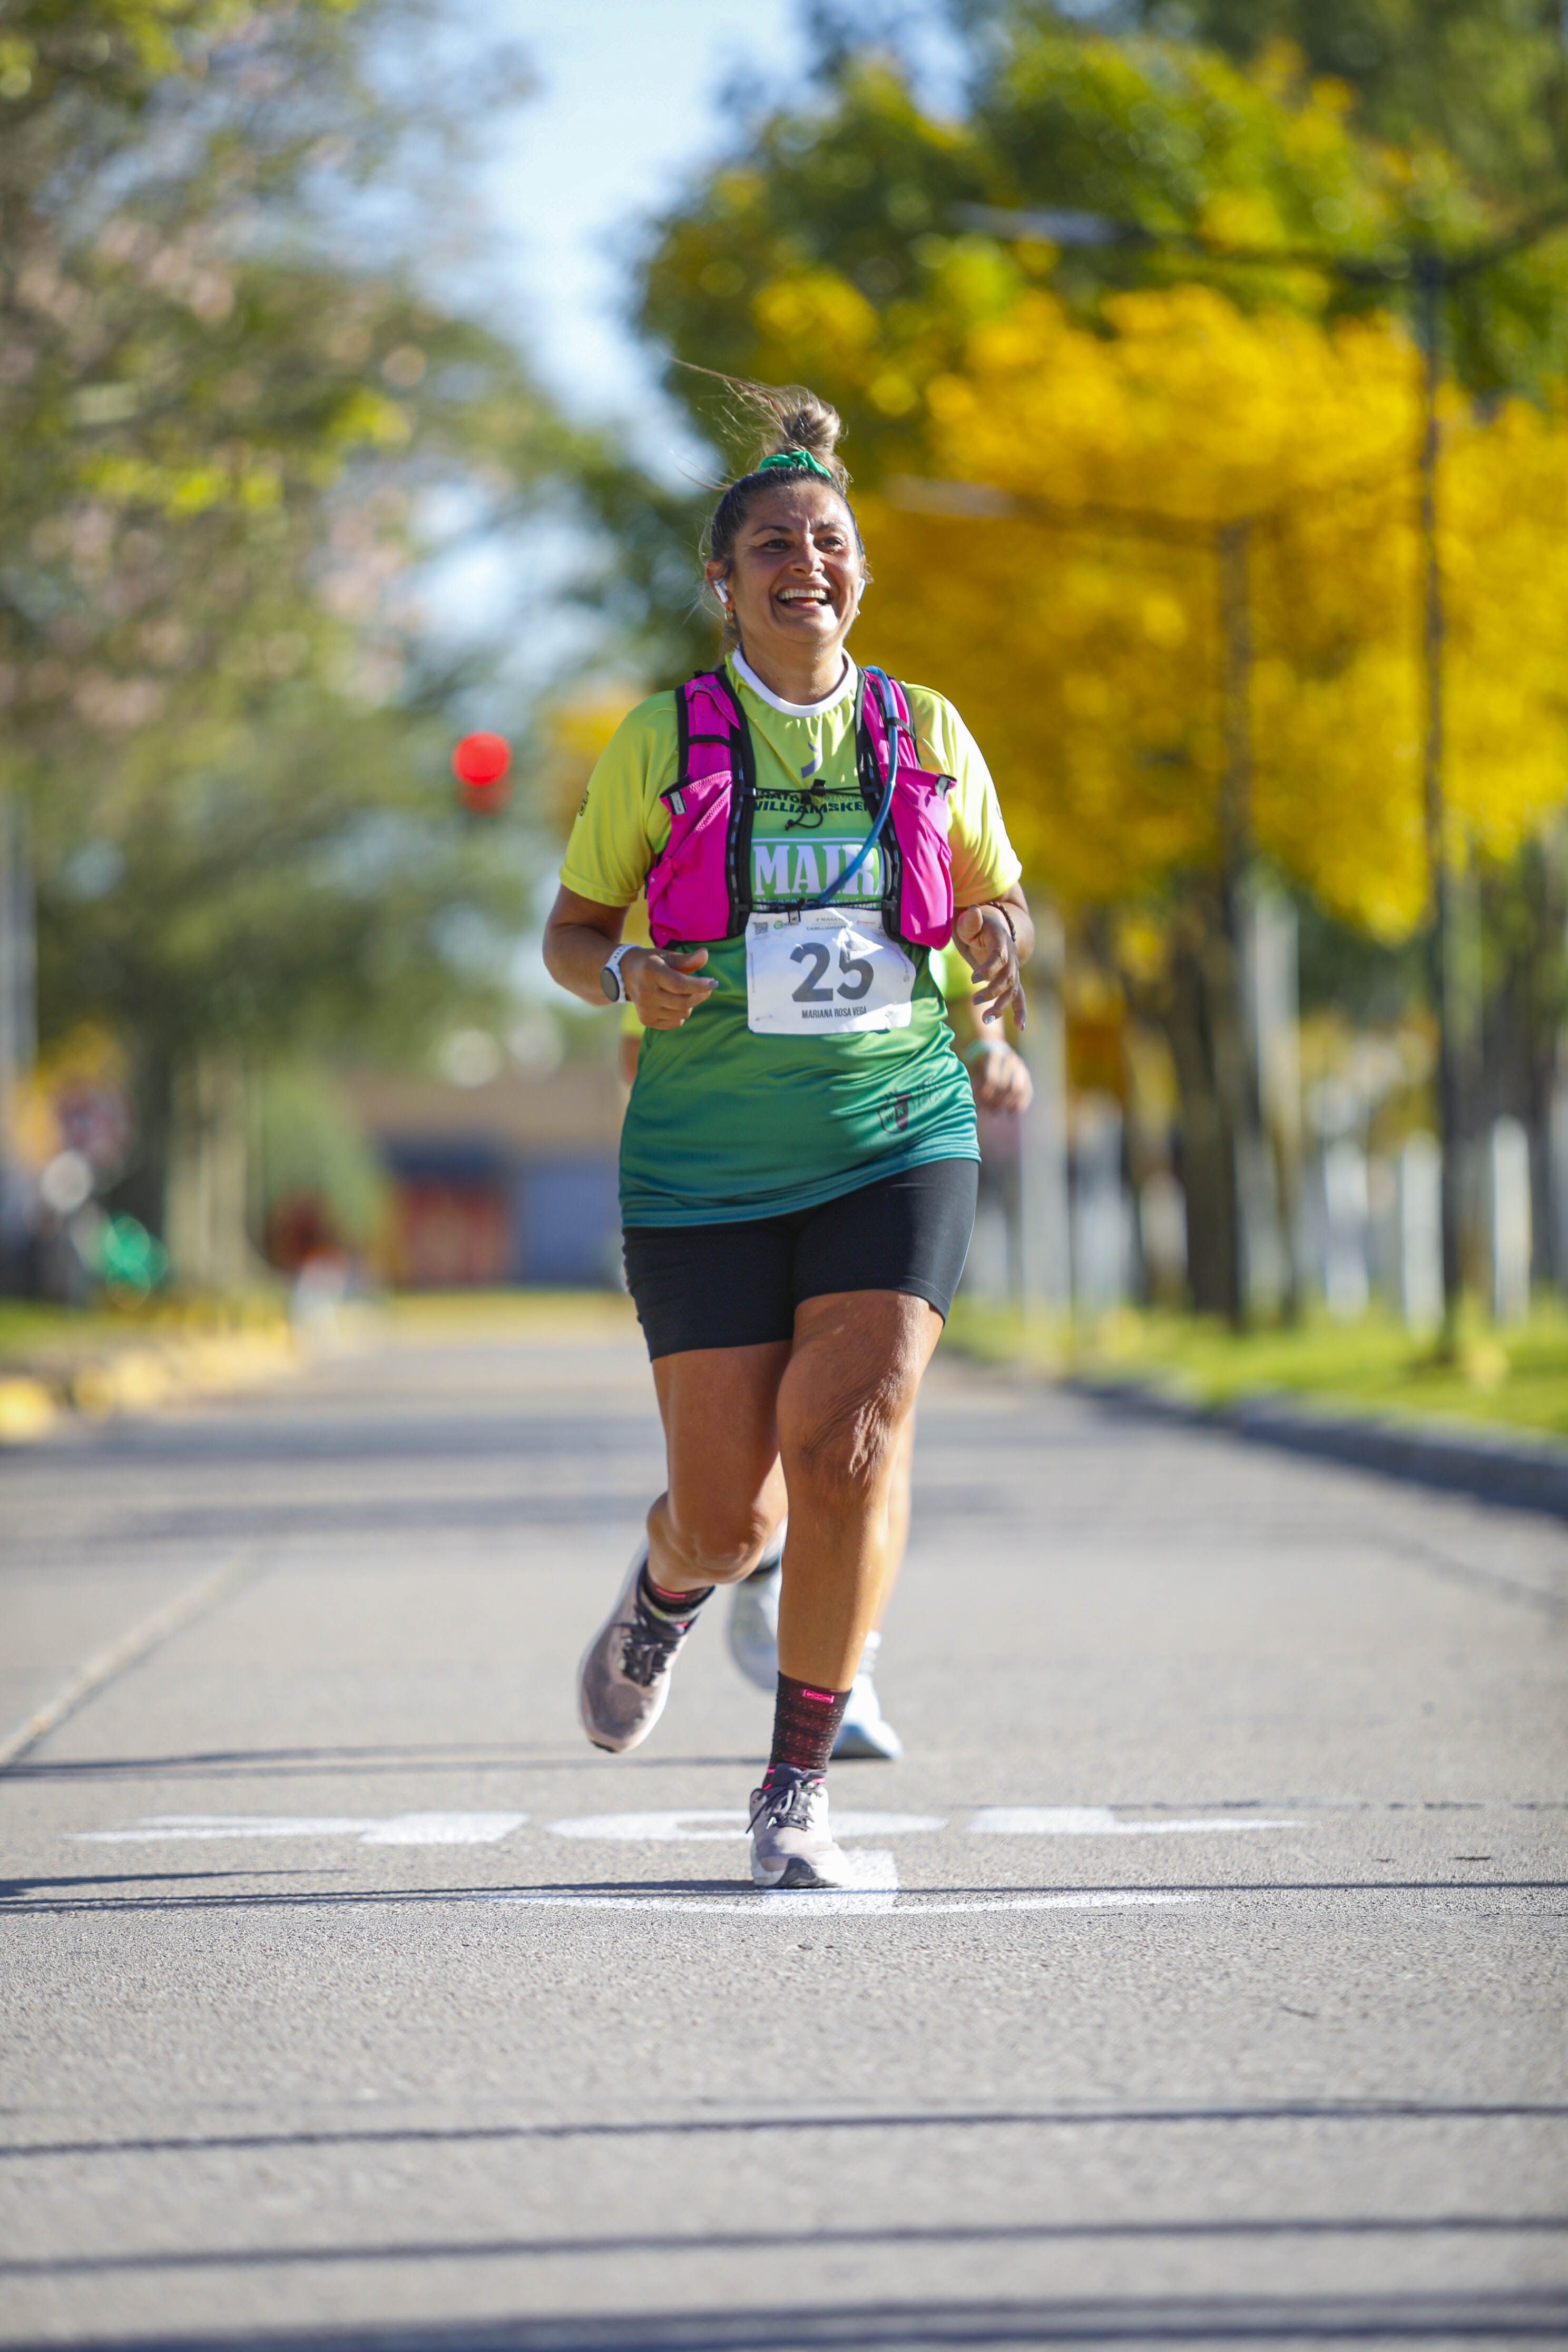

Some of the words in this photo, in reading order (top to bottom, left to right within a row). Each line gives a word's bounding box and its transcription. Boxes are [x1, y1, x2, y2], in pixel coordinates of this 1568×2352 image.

[752, 844, 885, 895] MAIR
[789, 941, 874, 1002] 25
[801, 1007, 833, 1019] MARIANA
[834, 1006, 851, 1017] ROSA
[852, 1005, 867, 1016] VEGA
